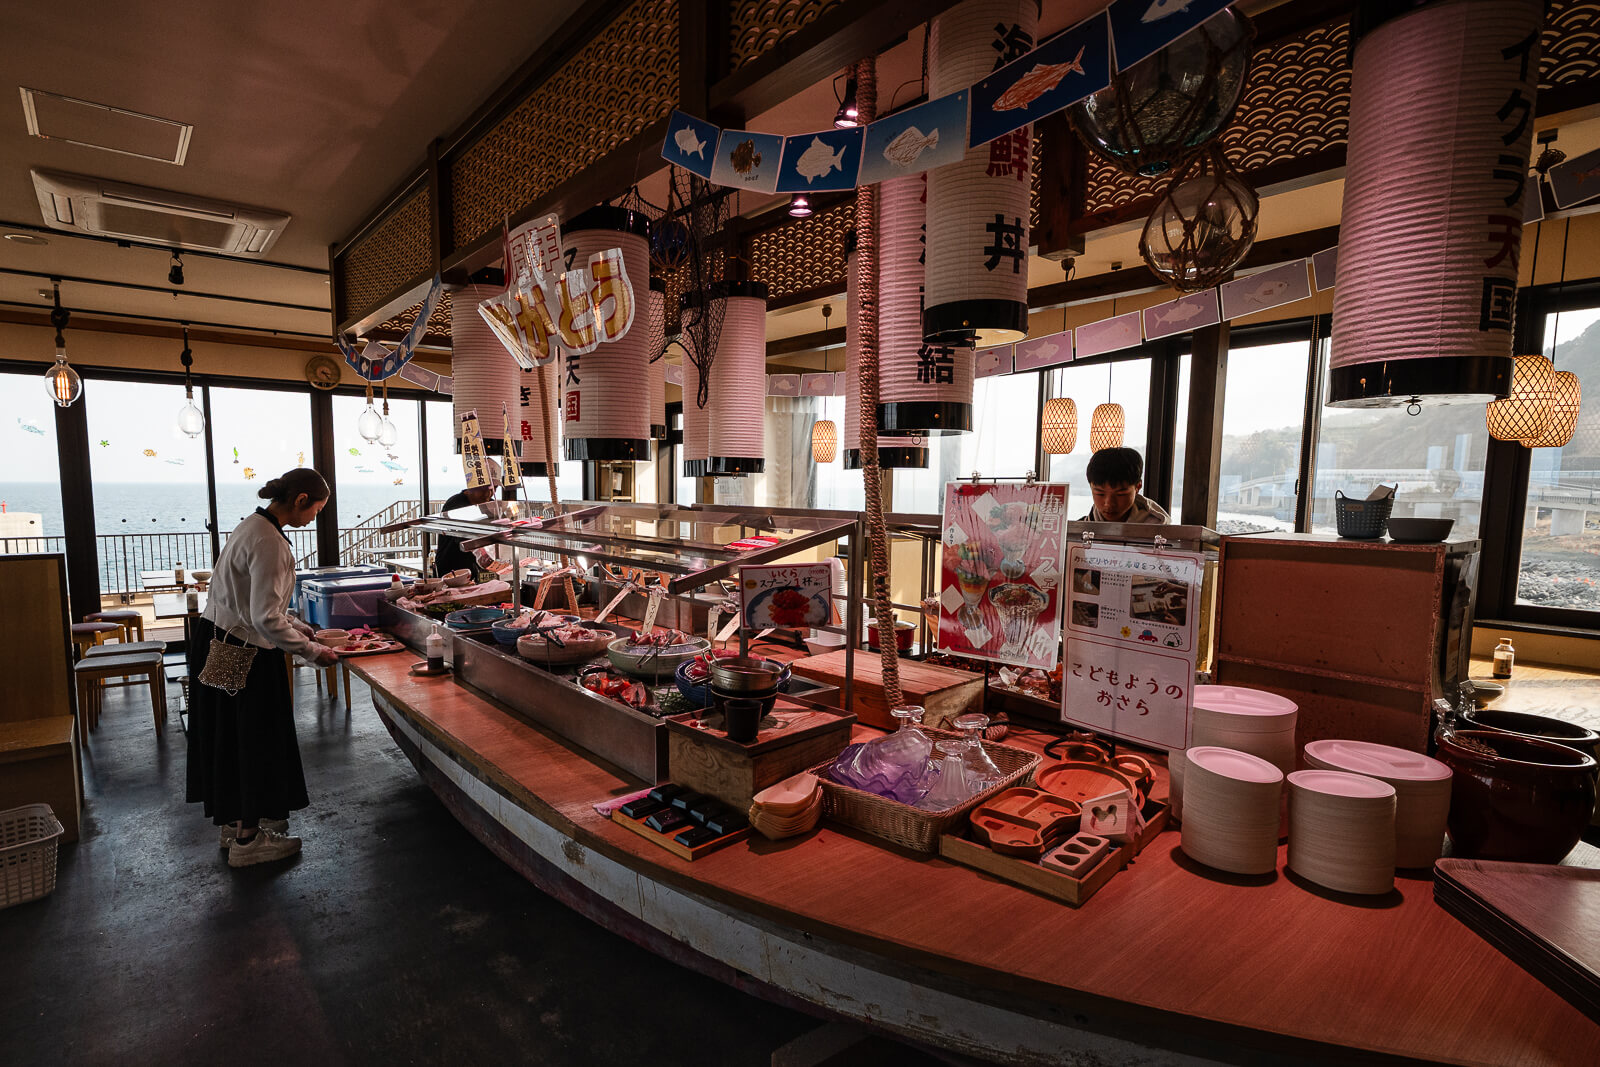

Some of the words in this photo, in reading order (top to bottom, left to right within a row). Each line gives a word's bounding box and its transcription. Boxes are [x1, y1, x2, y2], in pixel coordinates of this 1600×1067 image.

[1478, 28, 1539, 333] イクラ天国
[503, 222, 558, 292] 周年
[1039, 492, 1063, 591] 寿司パフェ
[771, 568, 799, 578] いくら
[1072, 662, 1184, 700] こどもようの
[1096, 689, 1151, 716] おさら
